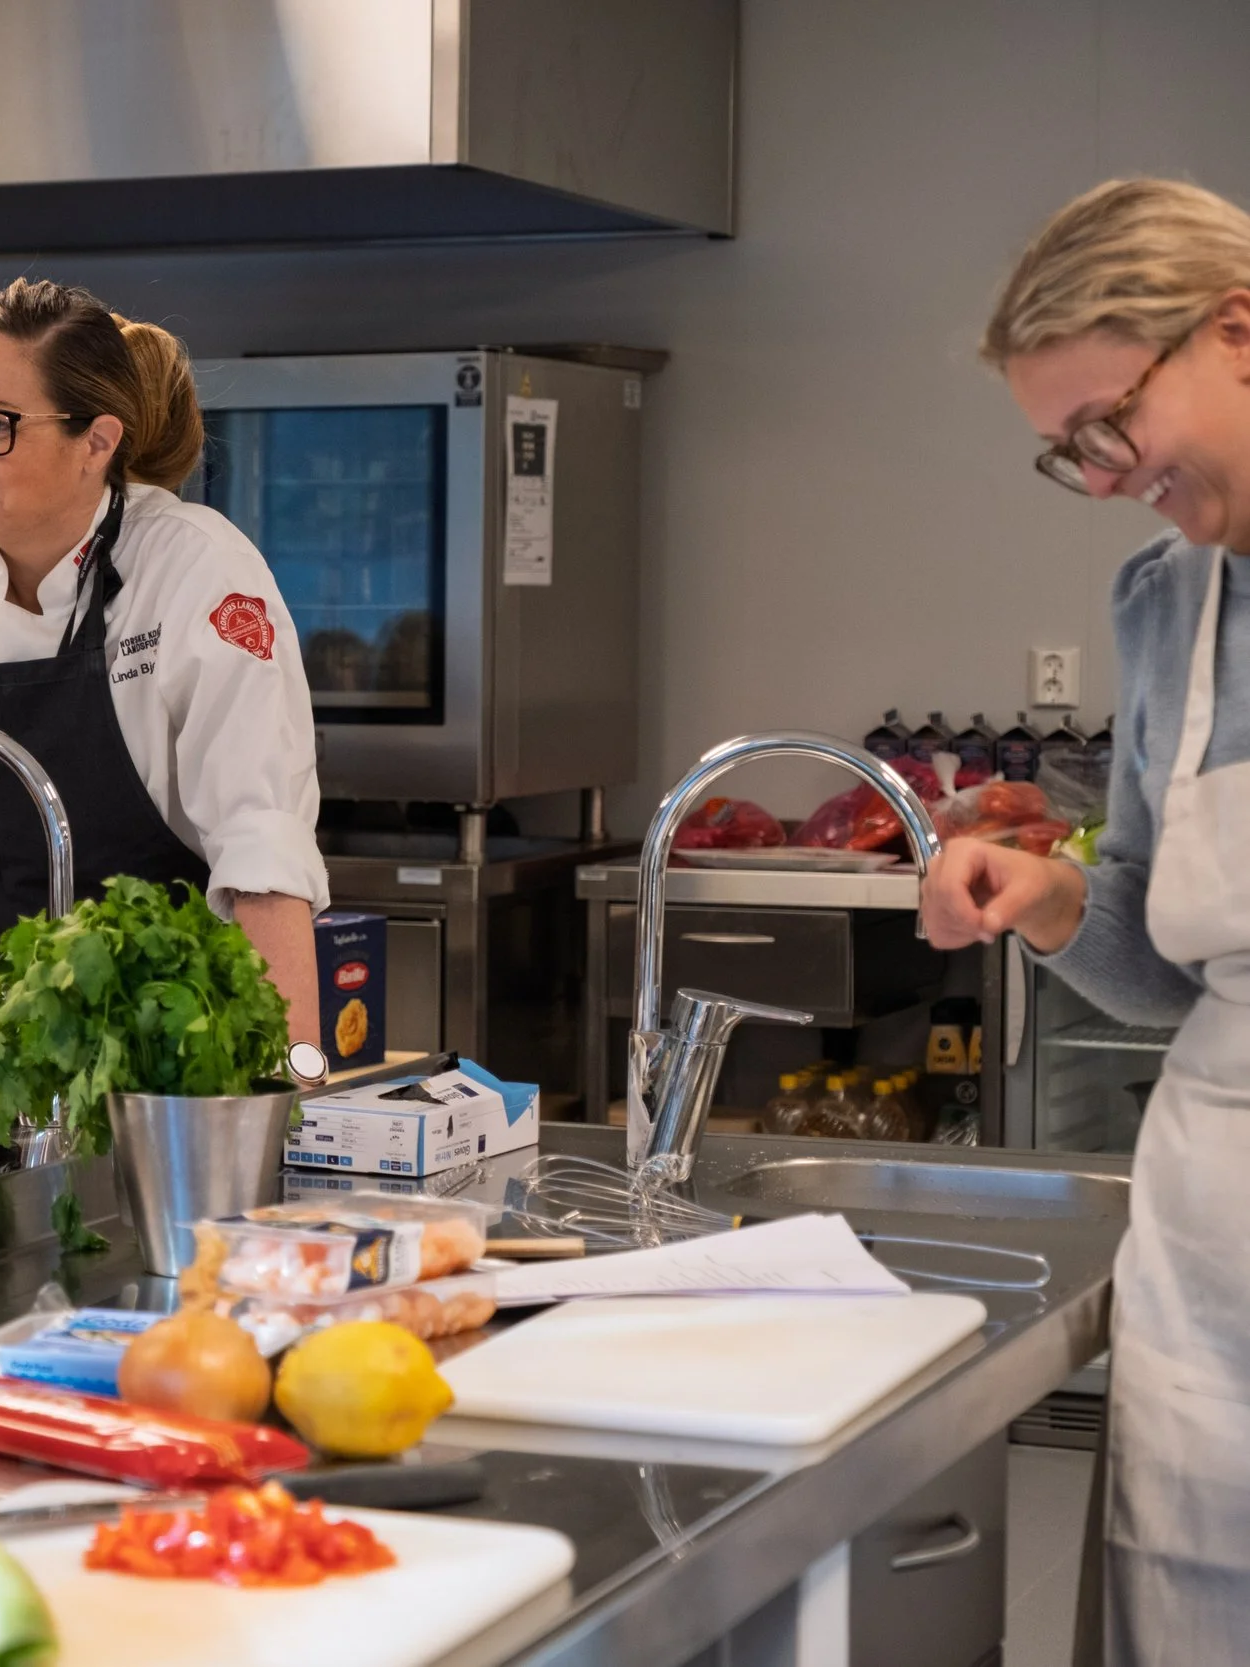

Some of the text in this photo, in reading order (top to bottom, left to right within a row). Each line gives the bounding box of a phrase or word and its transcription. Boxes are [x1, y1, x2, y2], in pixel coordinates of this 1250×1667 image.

[119, 633, 147, 649] NORSKE
[121, 637, 160, 656] LANDSFOR
[111, 668, 138, 684] Linda
[454, 1145, 471, 1156] Gloves
